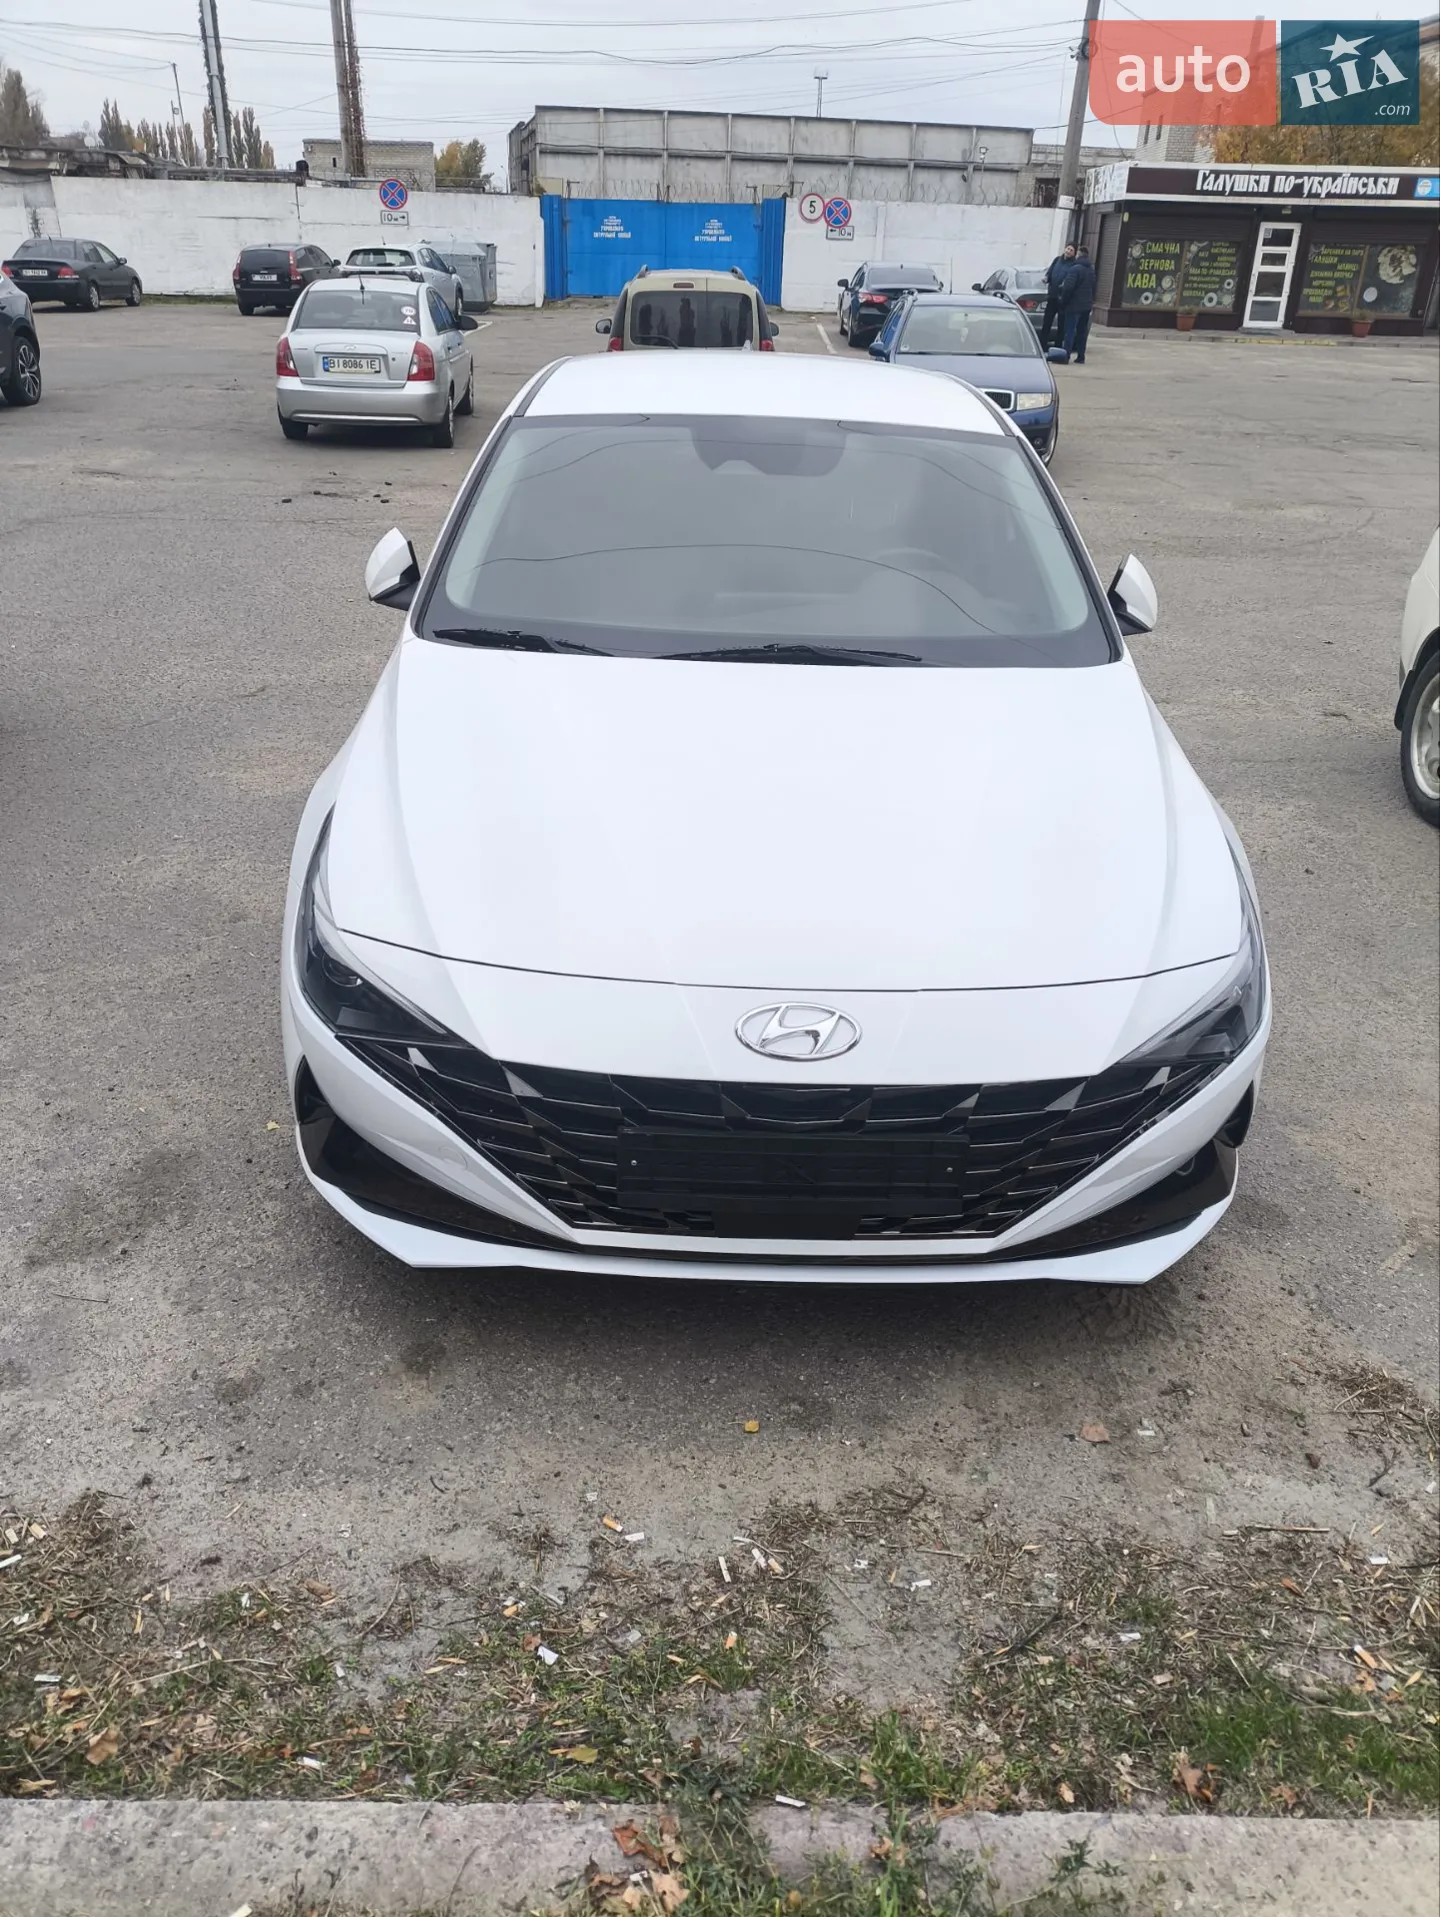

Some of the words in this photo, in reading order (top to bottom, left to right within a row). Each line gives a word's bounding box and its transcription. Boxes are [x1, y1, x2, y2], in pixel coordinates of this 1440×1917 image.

[1196, 170, 1270, 195] Галушки
[1274, 173, 1400, 198] по-українськи
[809, 200, 816, 214] 5
[1146, 242, 1180, 254] СМАЧНА
[1139, 259, 1175, 271] ЗЕРНОВА
[1127, 273, 1156, 289] КАВА
